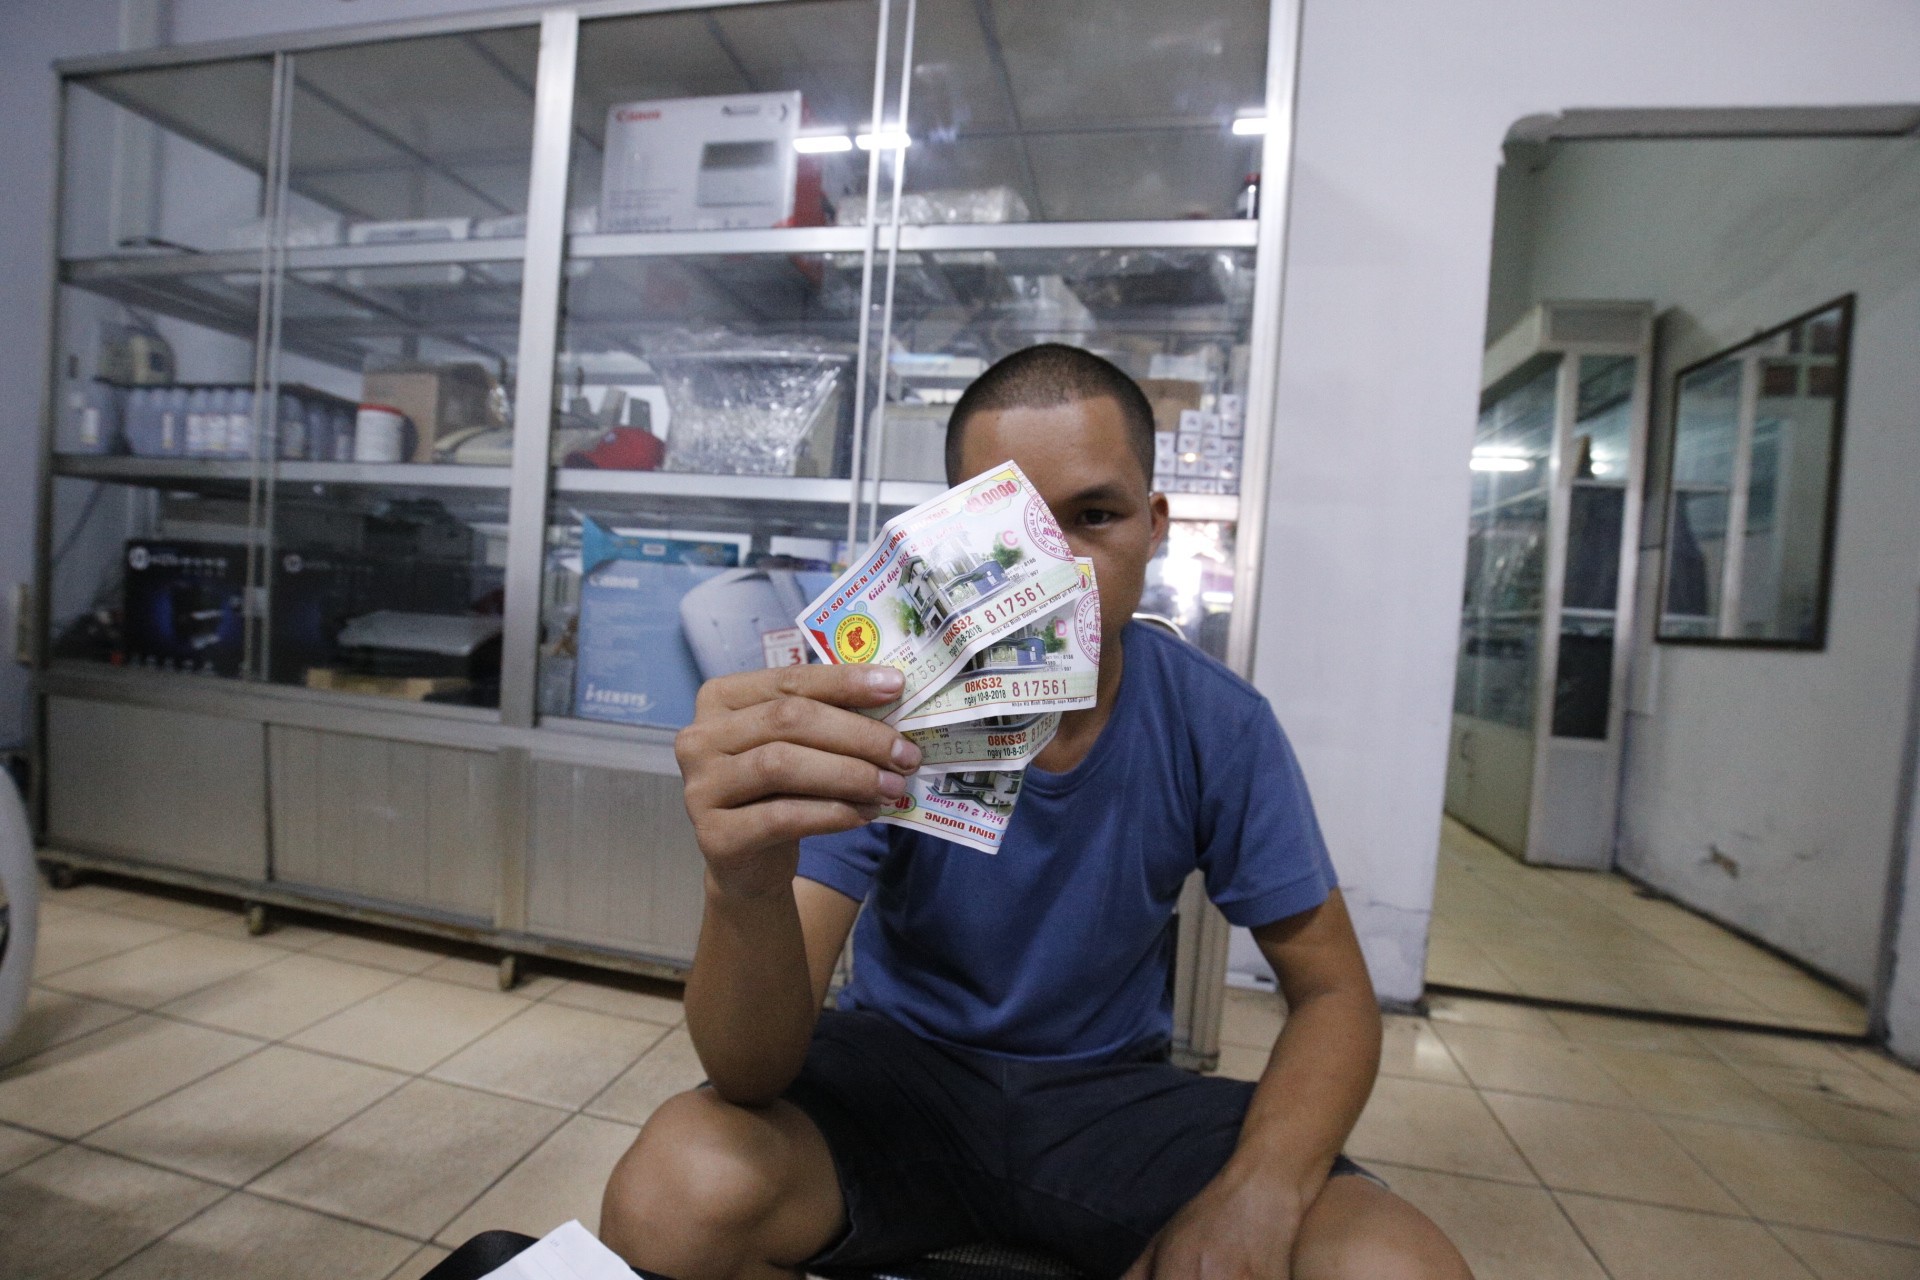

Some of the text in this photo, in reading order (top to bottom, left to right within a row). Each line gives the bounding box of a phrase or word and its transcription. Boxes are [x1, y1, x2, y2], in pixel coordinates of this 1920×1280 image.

[1002, 530, 1018, 546] C
[816, 608, 830, 624] XỔ
[831, 596, 844, 611] SỐ
[845, 575, 868, 598] KIẾN
[868, 550, 890, 575] THIẾT
[889, 530, 907, 551] BÌNH
[984, 582, 1045, 624] 817561
[943, 615, 975, 647] 08KS32
[1056, 620, 1067, 636] D
[964, 677, 1002, 694] 08KS32
[1012, 679, 1067, 697] 817561
[977, 689, 1006, 702] 10-8-2018
[988, 731, 1027, 746] 08KS32
[971, 808, 980, 816] 2
[925, 811, 966, 830] DƯƠNG
[968, 825, 996, 840] BÌNH
